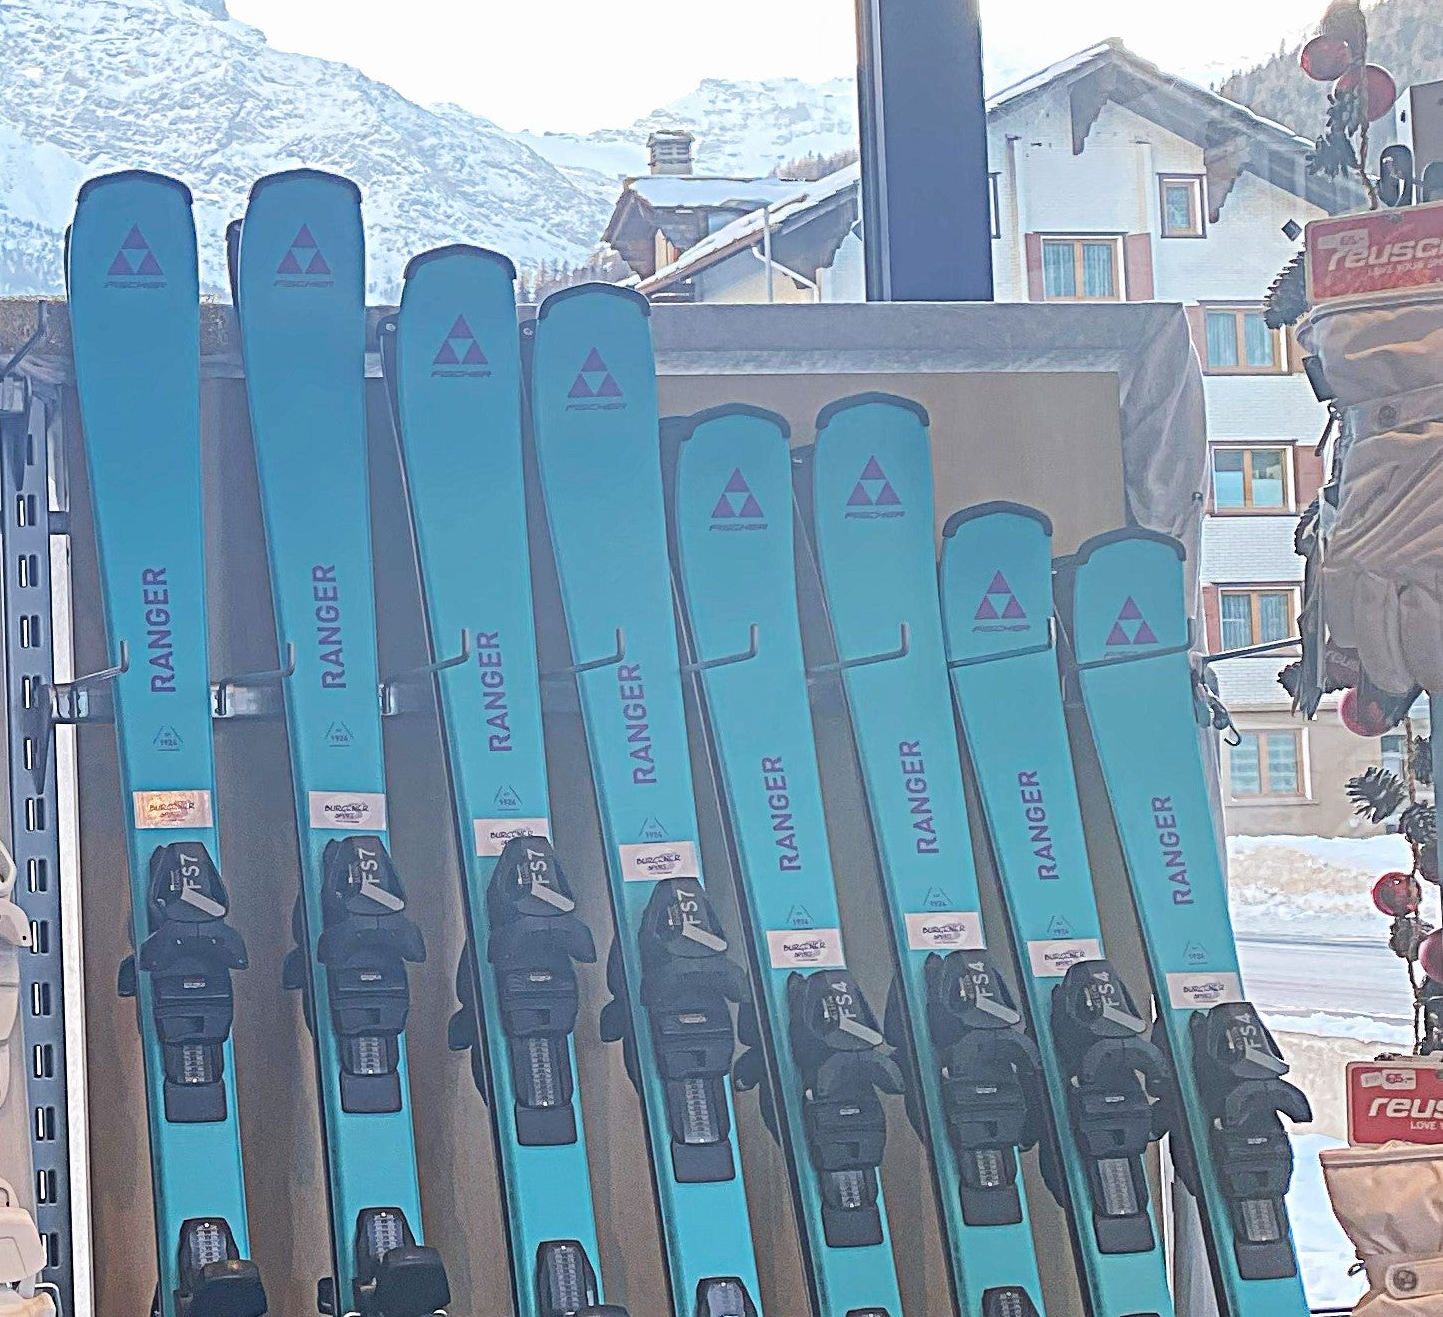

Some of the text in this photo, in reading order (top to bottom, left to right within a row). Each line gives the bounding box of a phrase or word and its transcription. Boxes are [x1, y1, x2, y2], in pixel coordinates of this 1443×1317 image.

[142, 566, 178, 692] RANGER
[312, 564, 348, 688] RANGER
[476, 630, 514, 752] RANGER
[618, 661, 658, 785] RANGER
[762, 756, 801, 872] RANGER
[898, 739, 940, 856] RANGER
[1018, 769, 1059, 880] RANGER
[358, 847, 381, 884] FS7
[527, 848, 551, 888] FS7
[1152, 794, 1195, 905] RANGER
[180, 853, 201, 891] FS7
[677, 889, 701, 927] FS7
[968, 961, 994, 999] FS4
[1097, 971, 1116, 1007] FS4
[832, 981, 858, 1020] FS4
[1240, 1013, 1262, 1050] FS4
[1369, 1097, 1443, 1119] reus
[1410, 1120, 1437, 1130] LOVE
